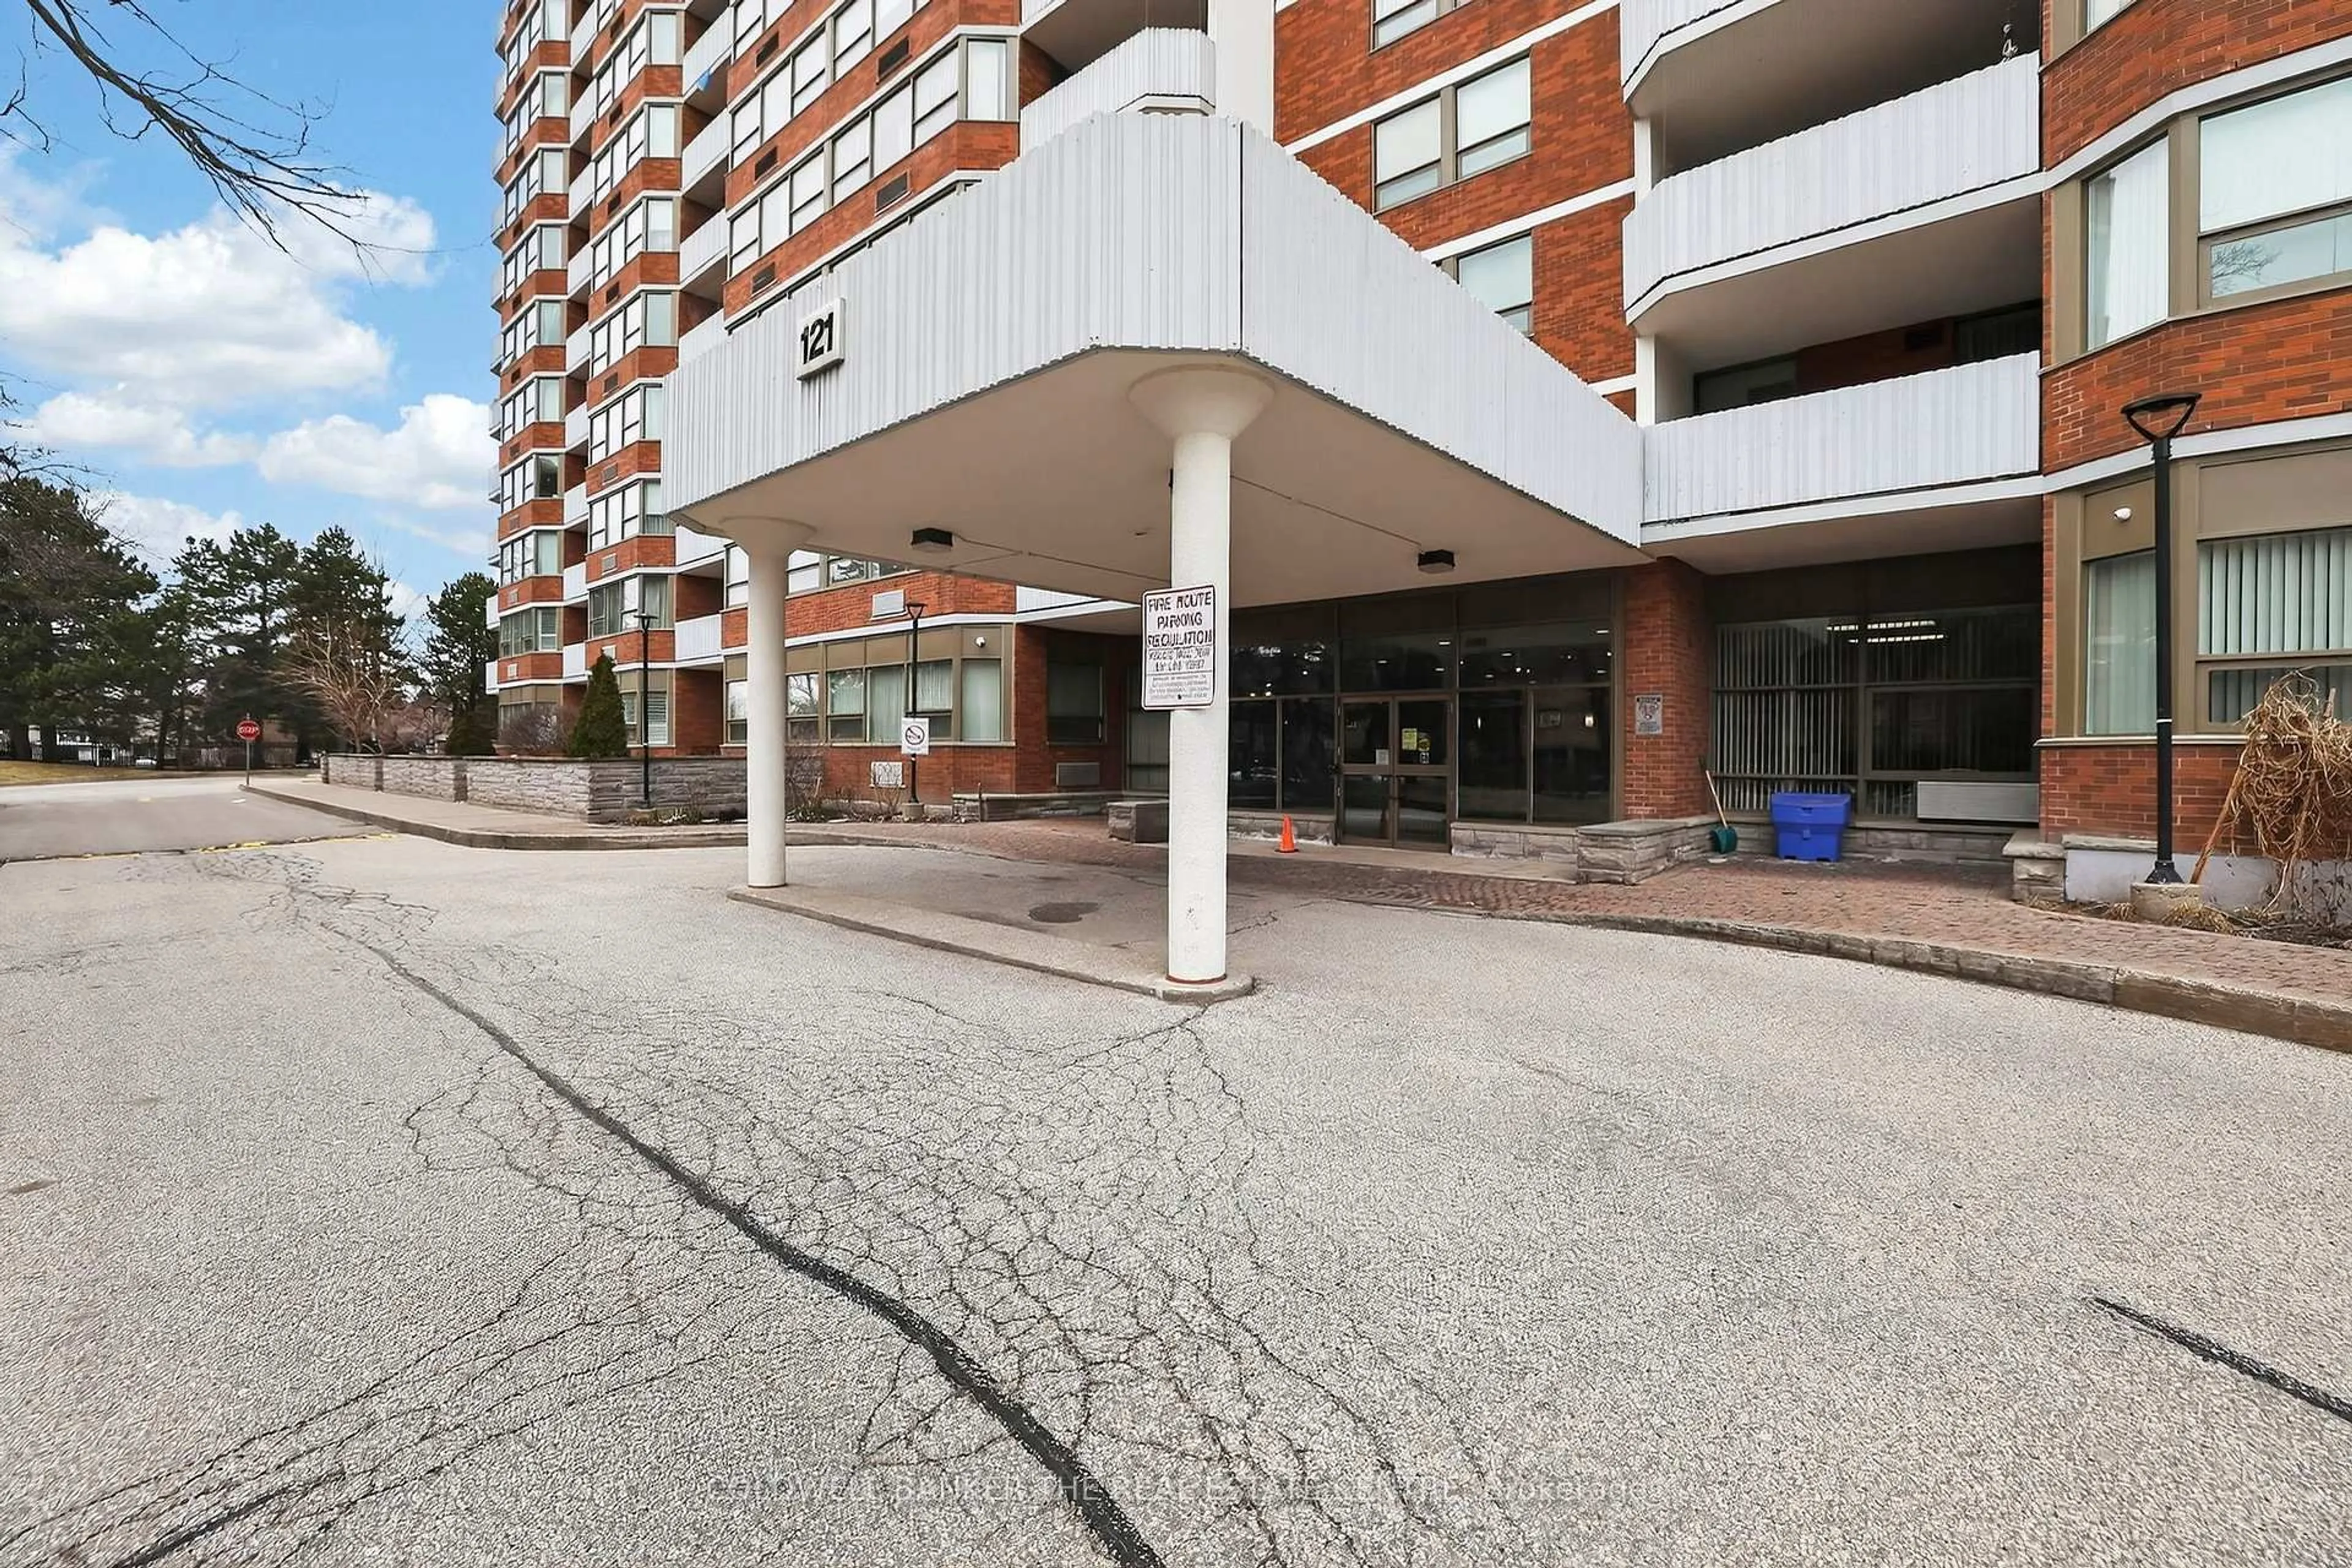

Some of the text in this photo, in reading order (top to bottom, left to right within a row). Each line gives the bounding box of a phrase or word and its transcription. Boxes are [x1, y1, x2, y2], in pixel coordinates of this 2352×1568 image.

[801, 312, 834, 364] 121
[1148, 591, 1212, 612] FIRE ROUTE
